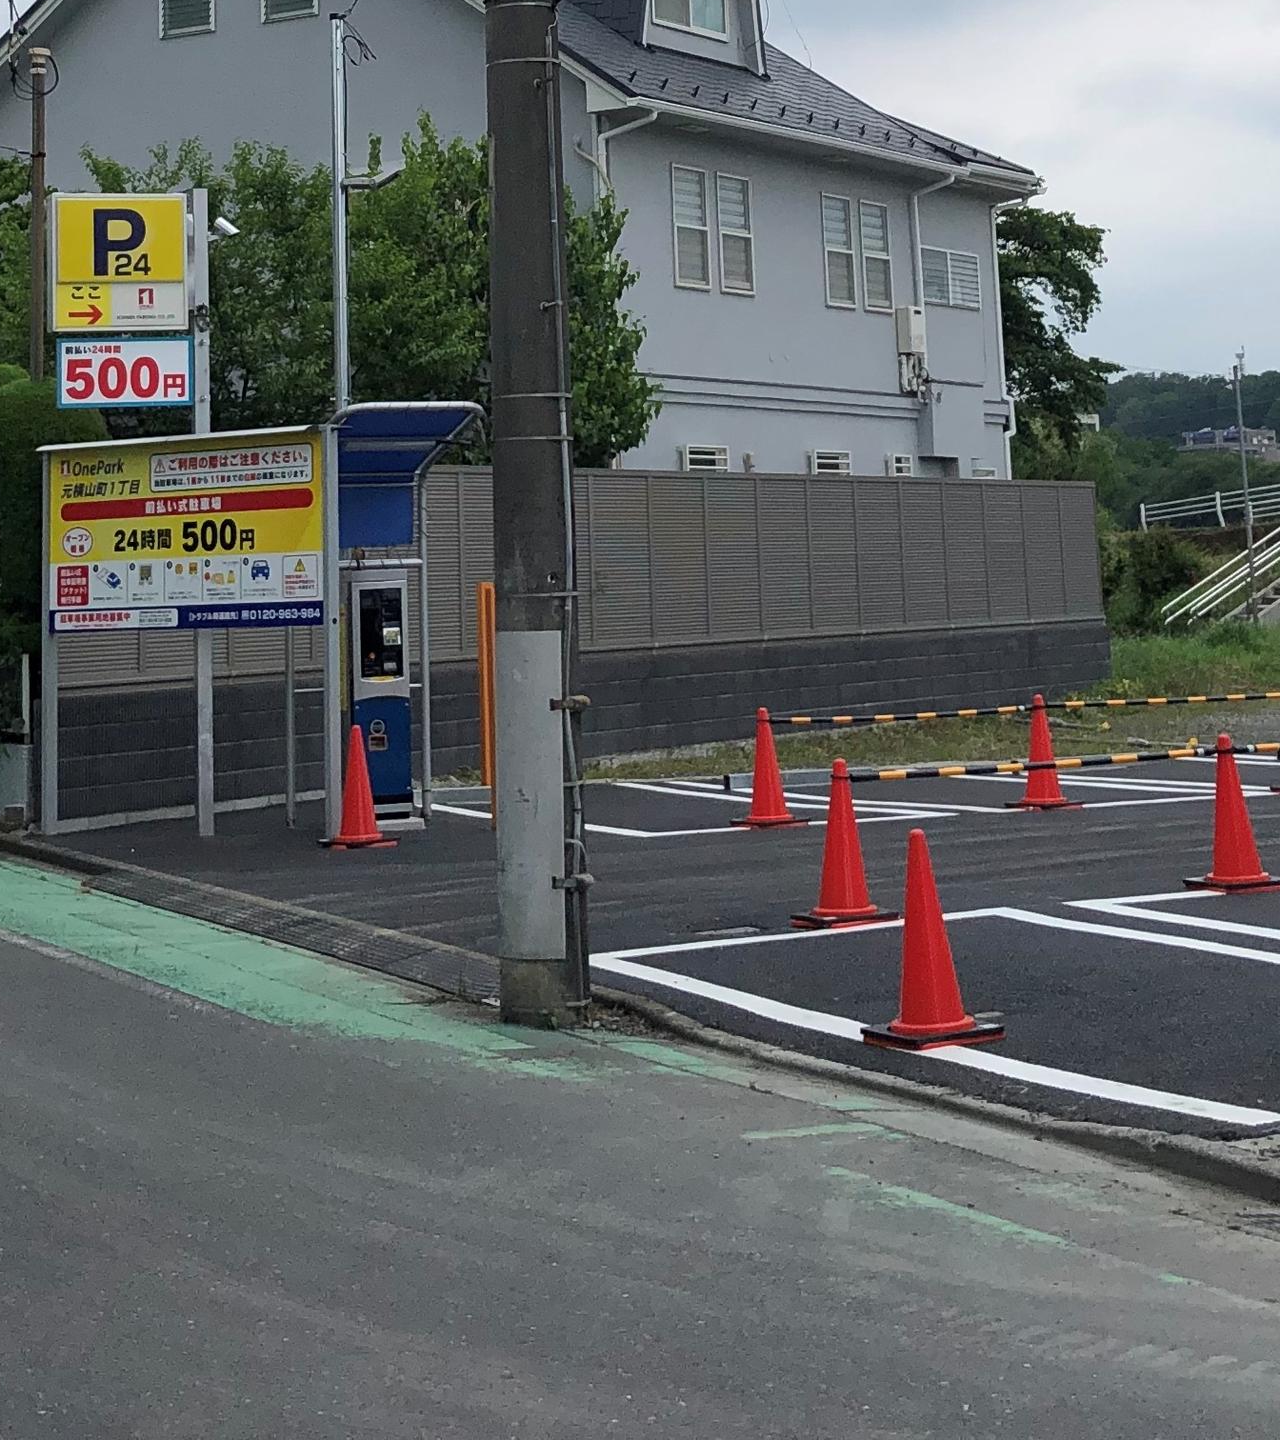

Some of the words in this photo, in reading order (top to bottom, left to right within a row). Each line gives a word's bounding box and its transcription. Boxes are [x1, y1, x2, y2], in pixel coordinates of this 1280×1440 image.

[93, 208, 147, 276] P
[114, 253, 152, 276] 24
[71, 286, 101, 300] ここ
[65, 345, 121, 355] 前払い24時間
[65, 356, 186, 400] 500円
[72, 458, 125, 477] OnePark
[145, 497, 222, 514] 前払い式駐車場
[113, 528, 172, 553] 24時間
[181, 518, 256, 553] 500円
